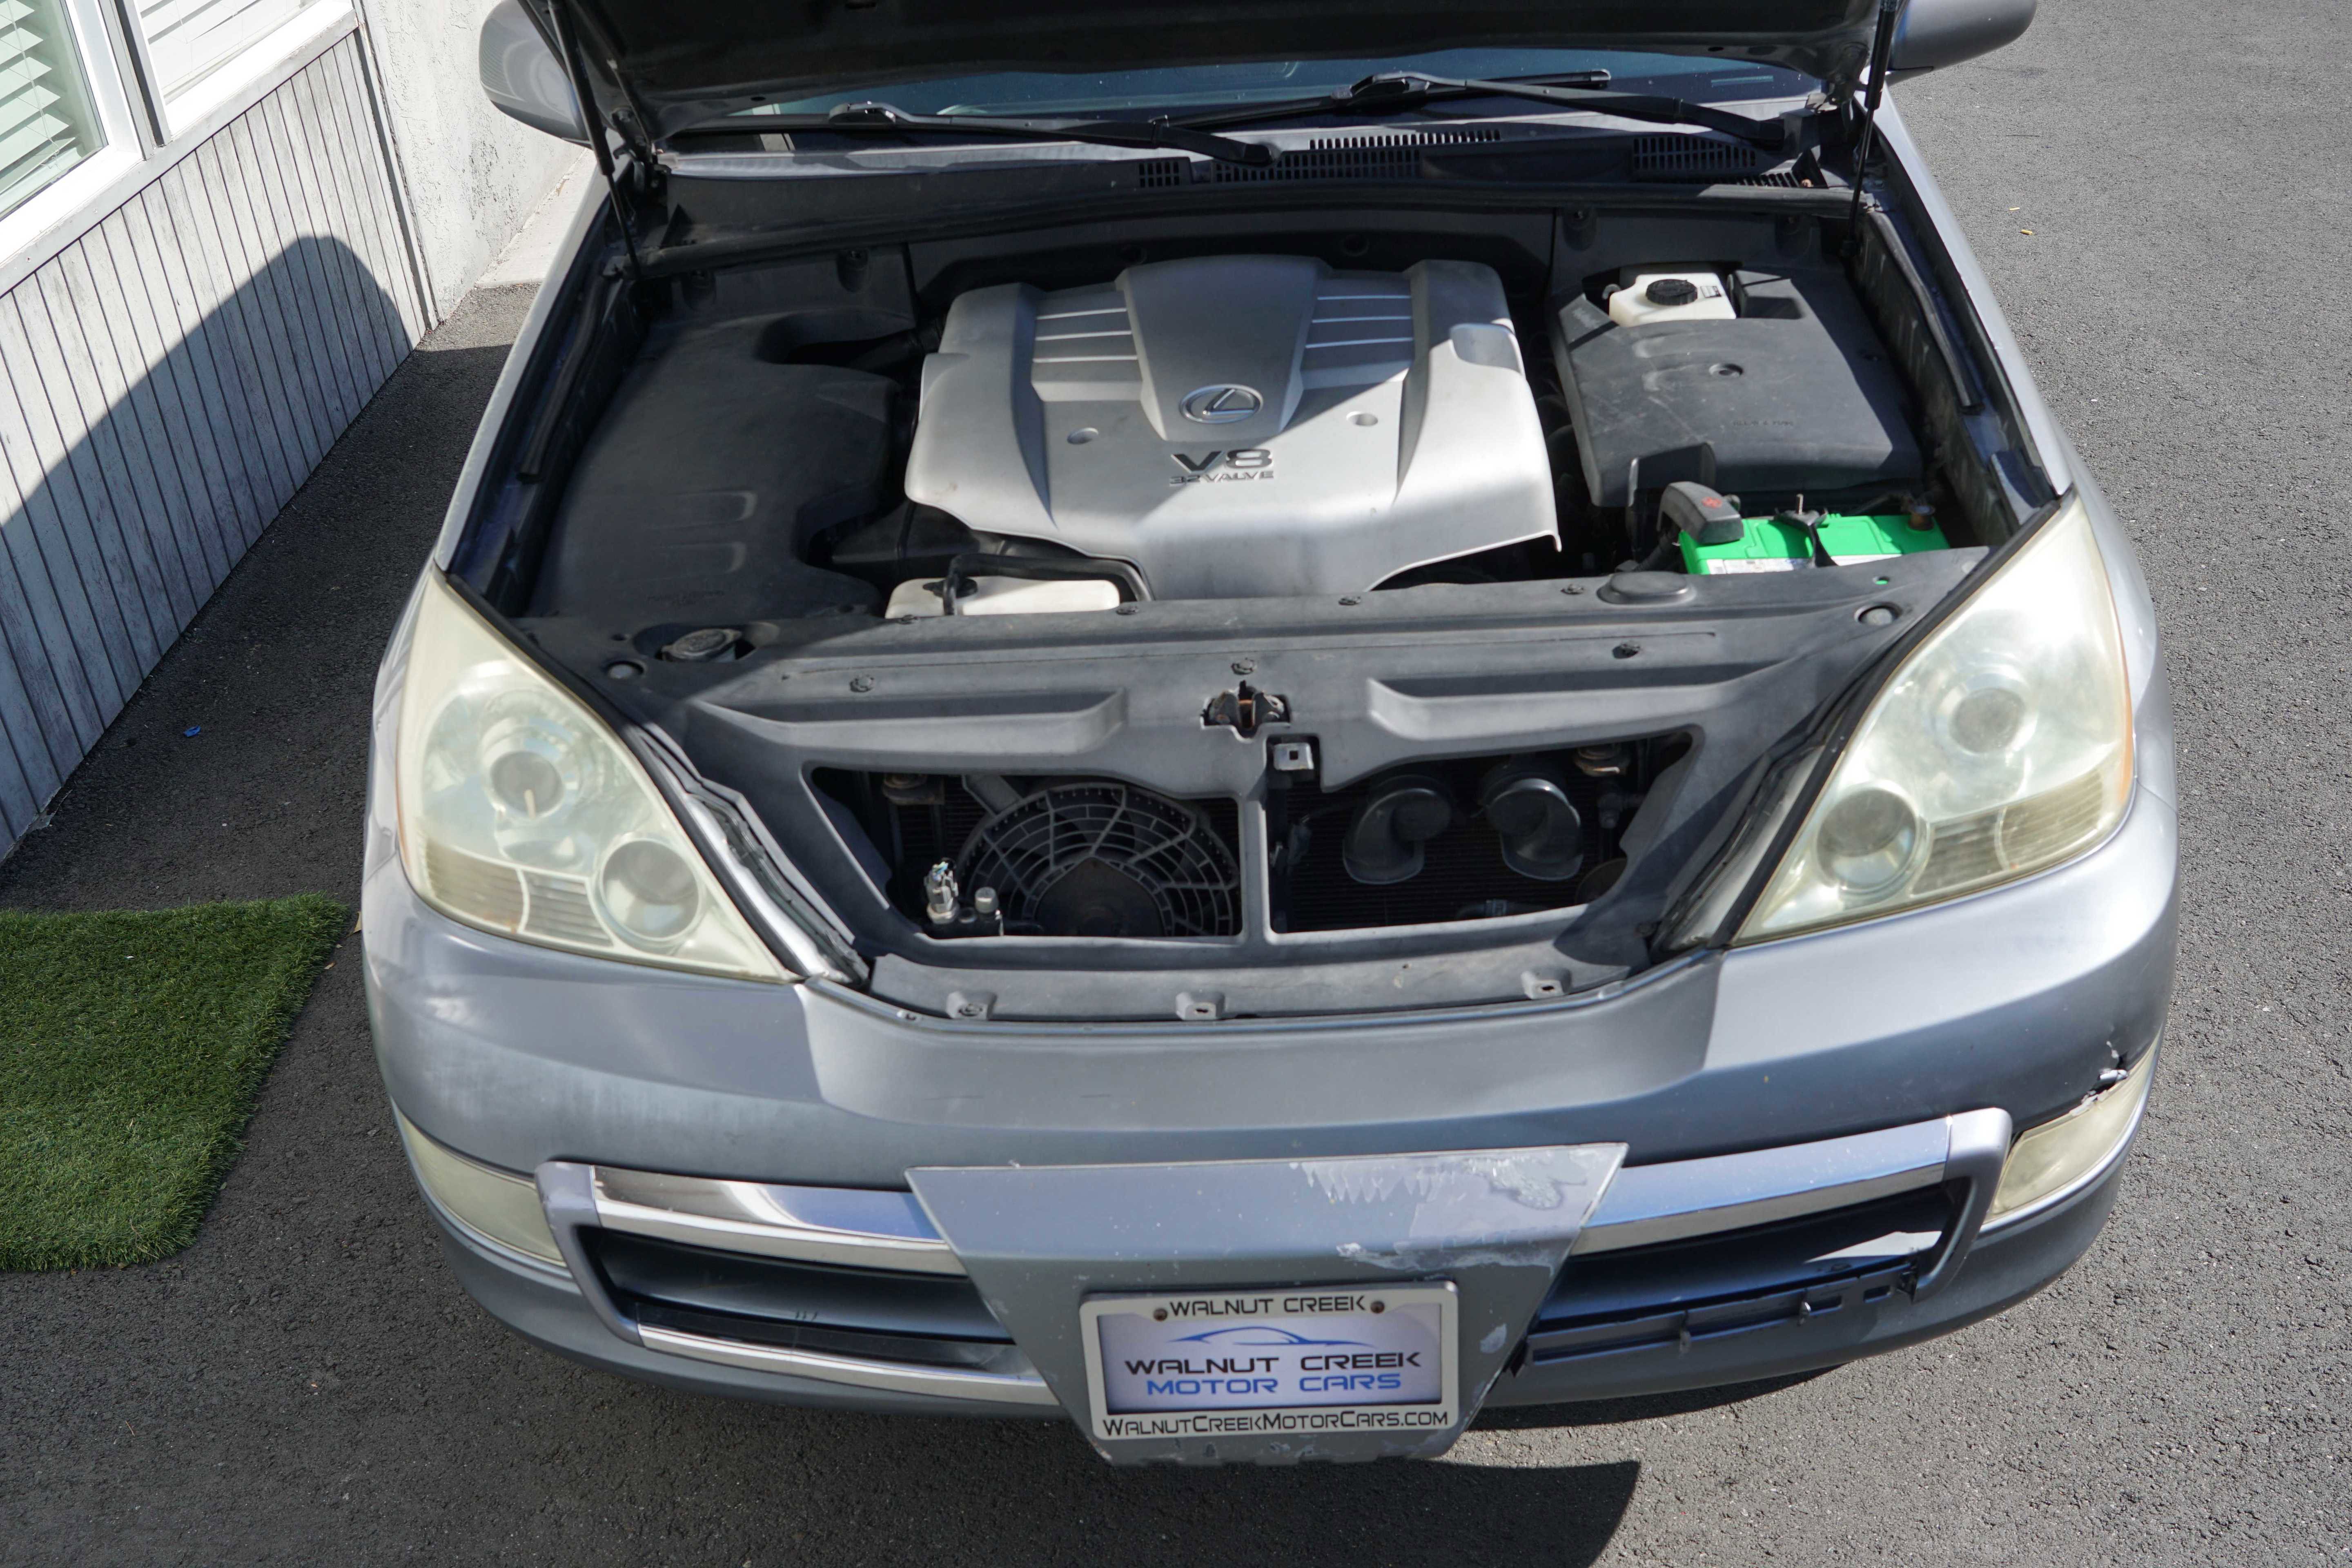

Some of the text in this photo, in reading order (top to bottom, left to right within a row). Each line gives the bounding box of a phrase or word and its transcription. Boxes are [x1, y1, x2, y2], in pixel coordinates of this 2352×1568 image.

[1170, 448, 1273, 473] V8
[1169, 1295, 1365, 1316] WALNUT CREEK
[1125, 1352, 1421, 1375] WALNUT CREEK
[1146, 1373, 1401, 1395] MOTOR CARS
